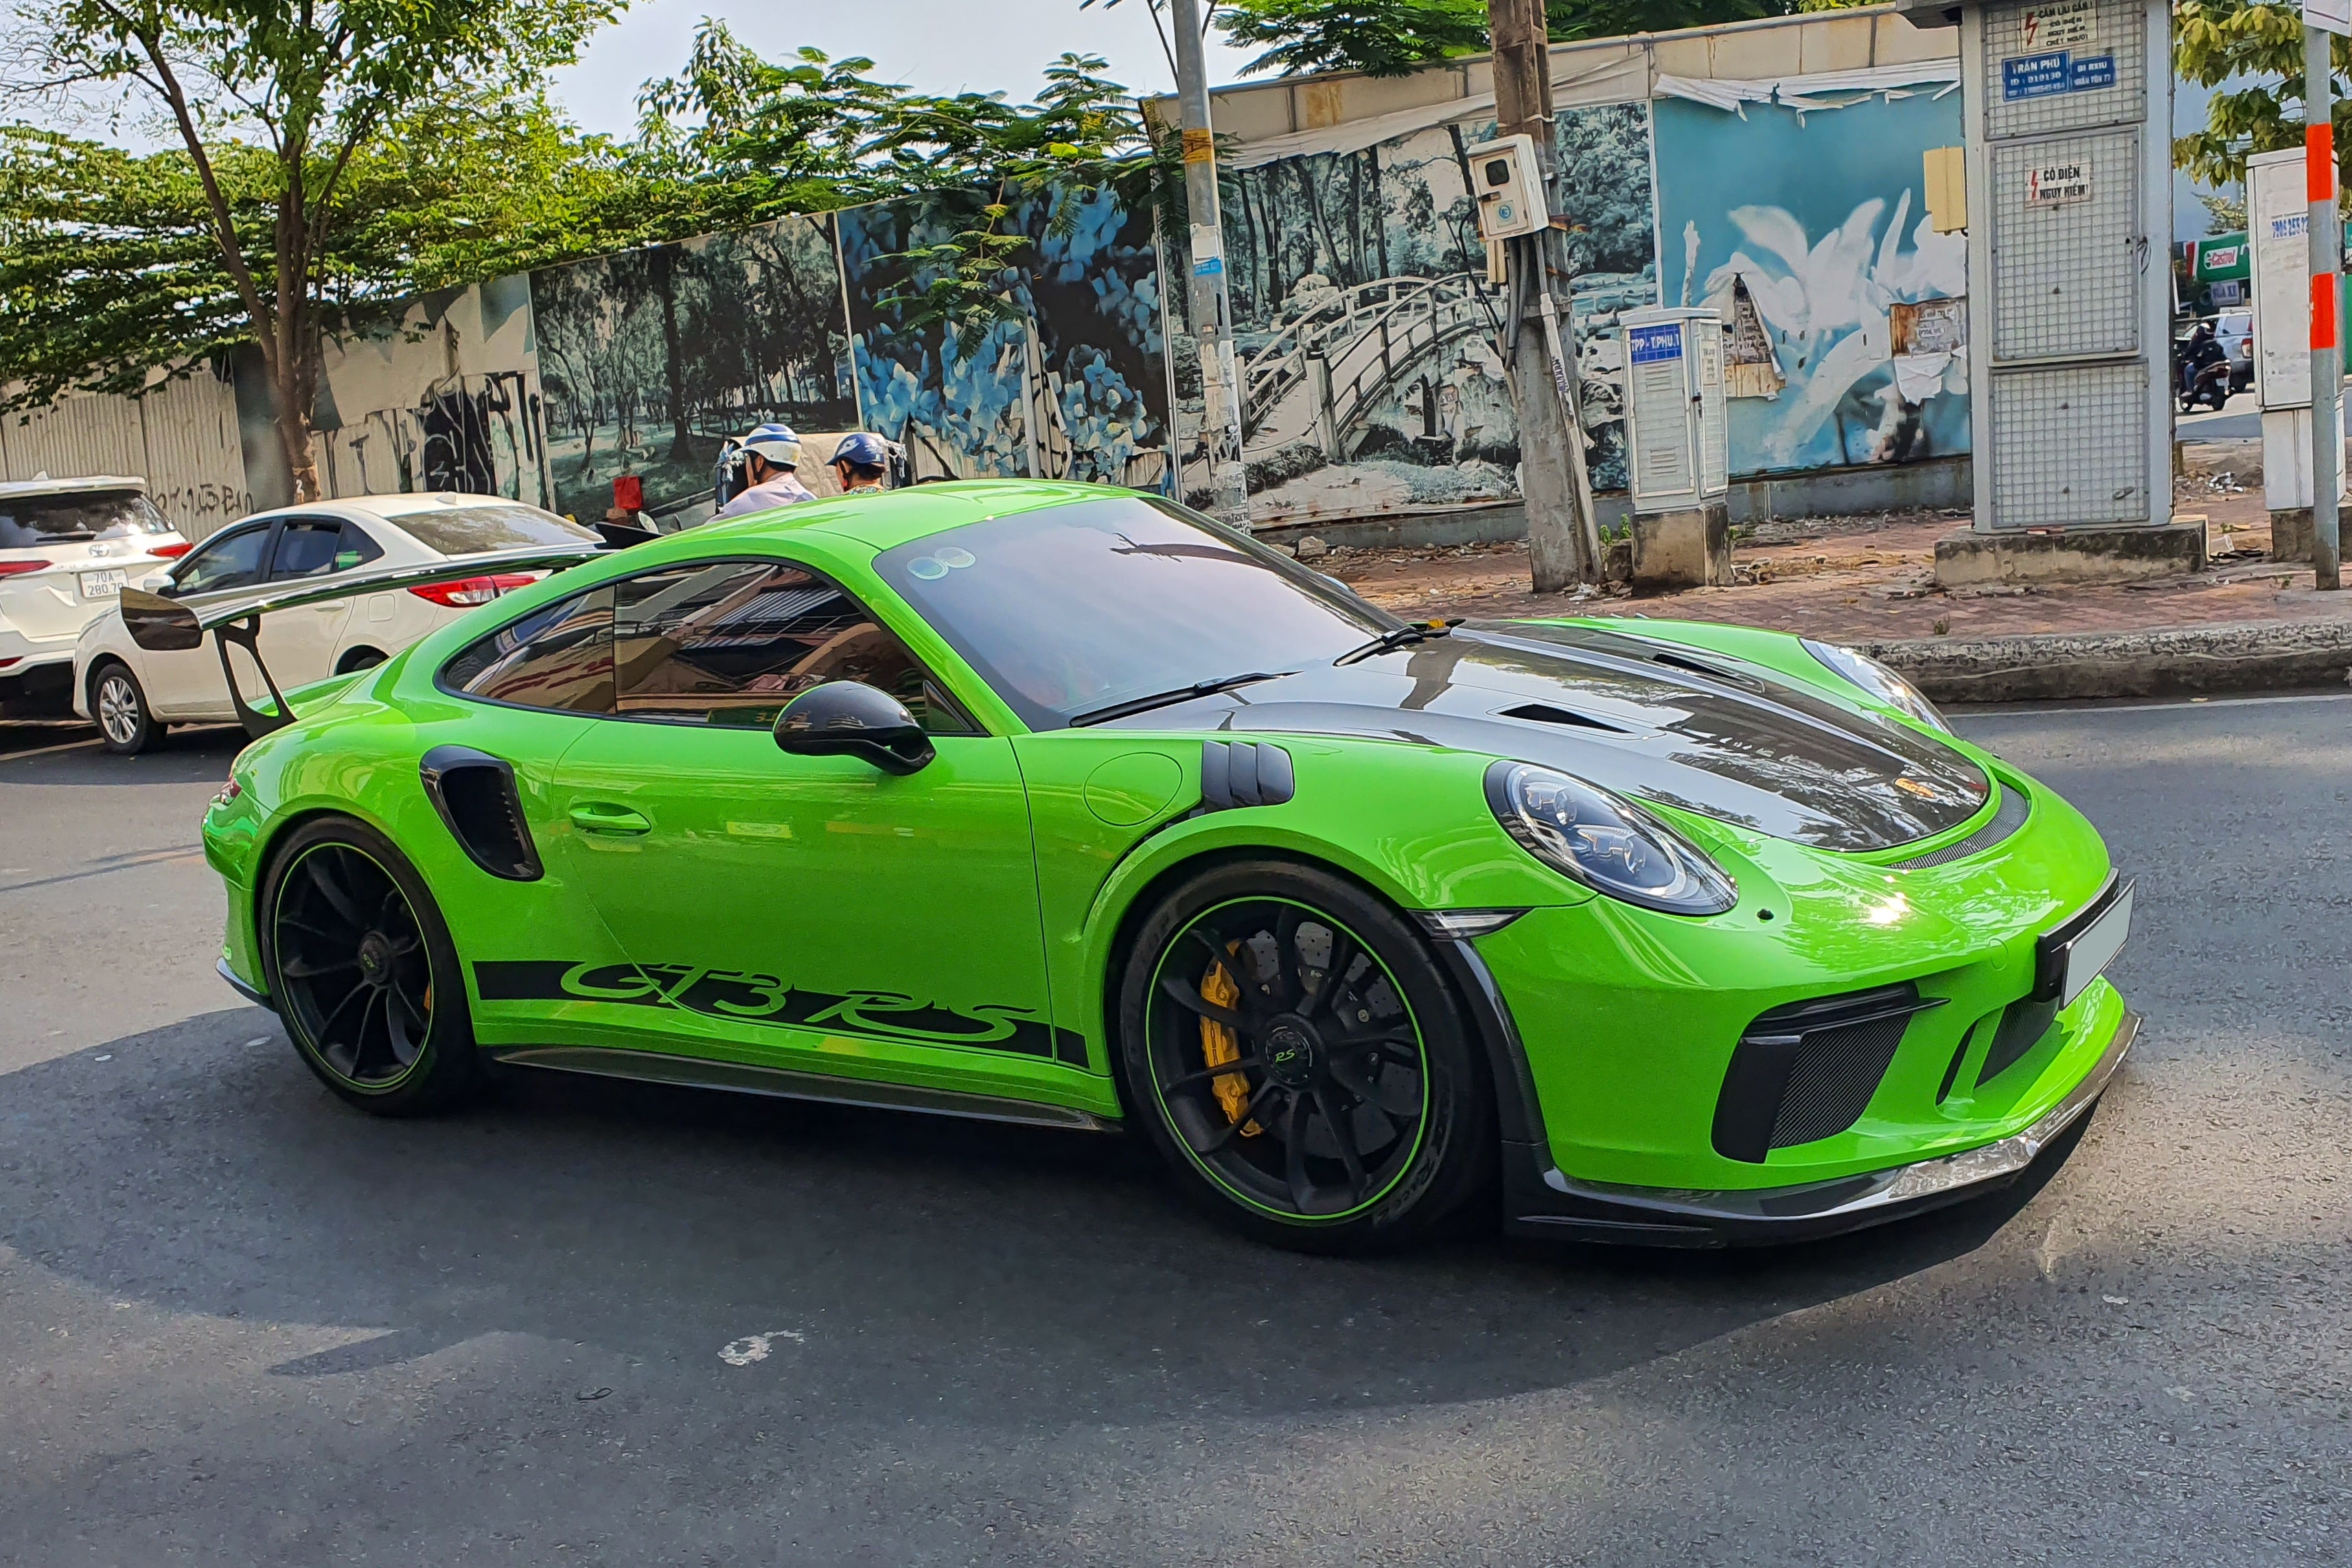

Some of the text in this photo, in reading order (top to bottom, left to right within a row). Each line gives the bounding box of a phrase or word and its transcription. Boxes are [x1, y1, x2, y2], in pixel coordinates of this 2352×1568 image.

[94, 570, 115, 584] 70A
[560, 960, 1038, 1043] GT3 RS
[1275, 1048, 1295, 1063] RS
